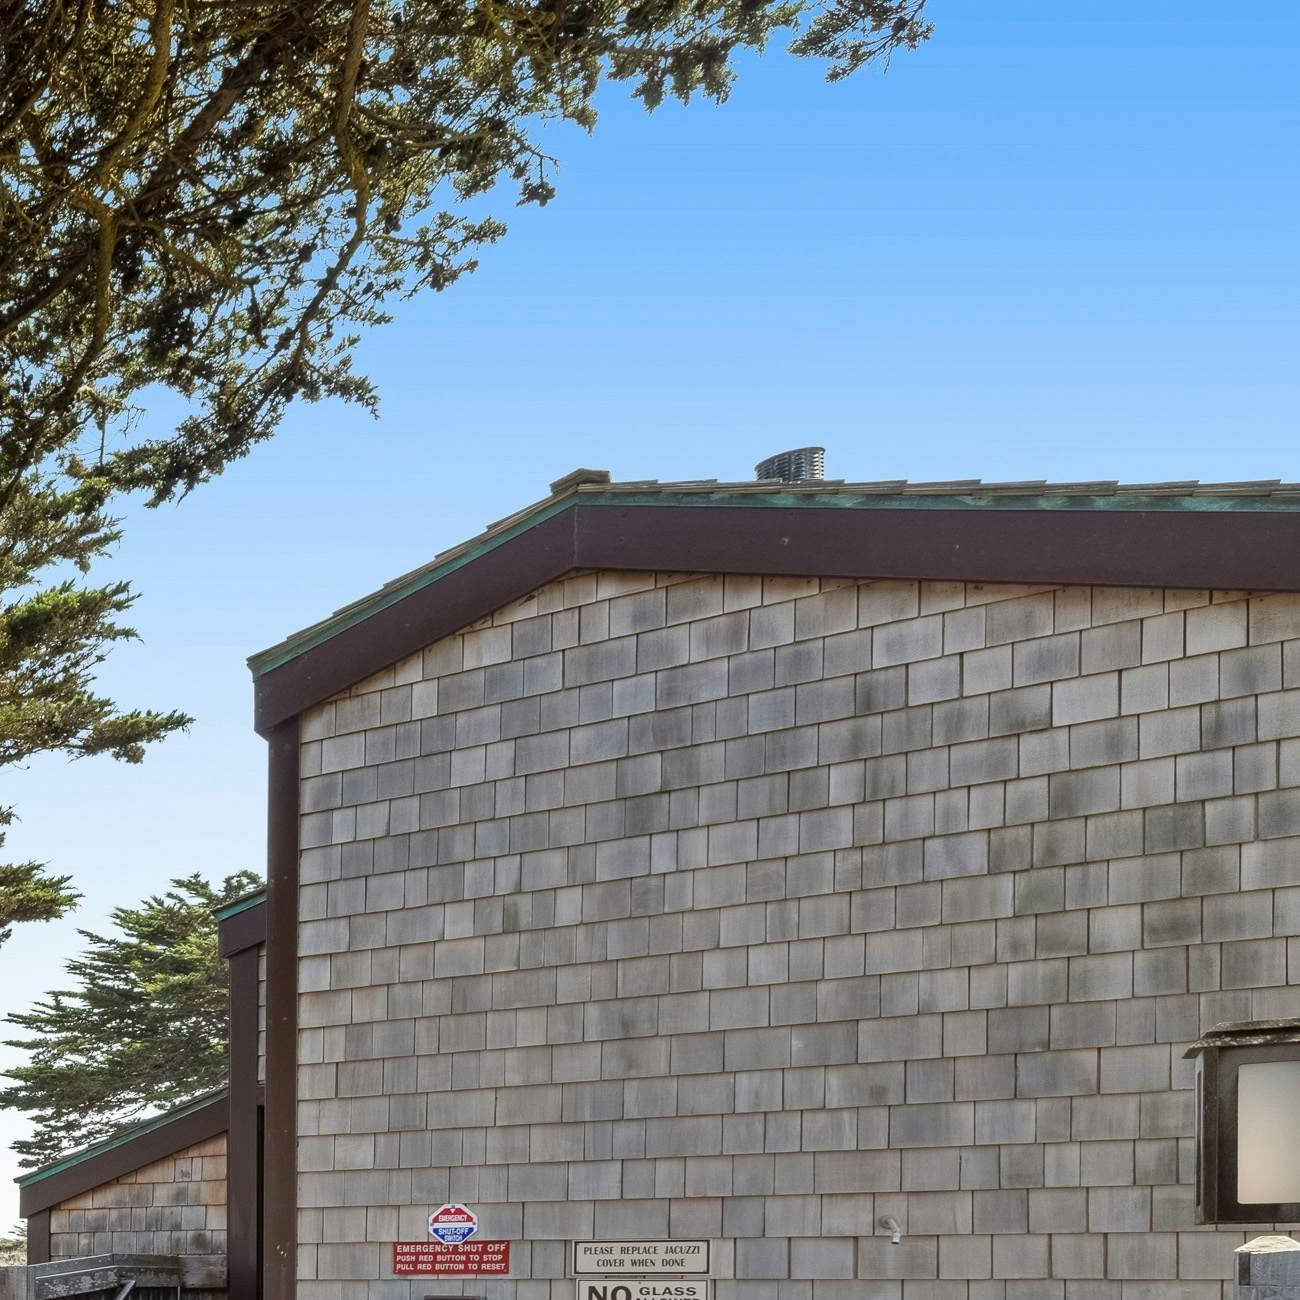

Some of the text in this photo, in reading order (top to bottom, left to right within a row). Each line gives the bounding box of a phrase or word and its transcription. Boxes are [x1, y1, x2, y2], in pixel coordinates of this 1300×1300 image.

[396, 1244, 506, 1252] EMERGENCY SHUT OFF
[583, 1246, 700, 1255] PLEASE REPLACE JACUZZI
[596, 1258, 686, 1267] COVER WHEN DONE
[639, 1287, 697, 1296] GLASS
